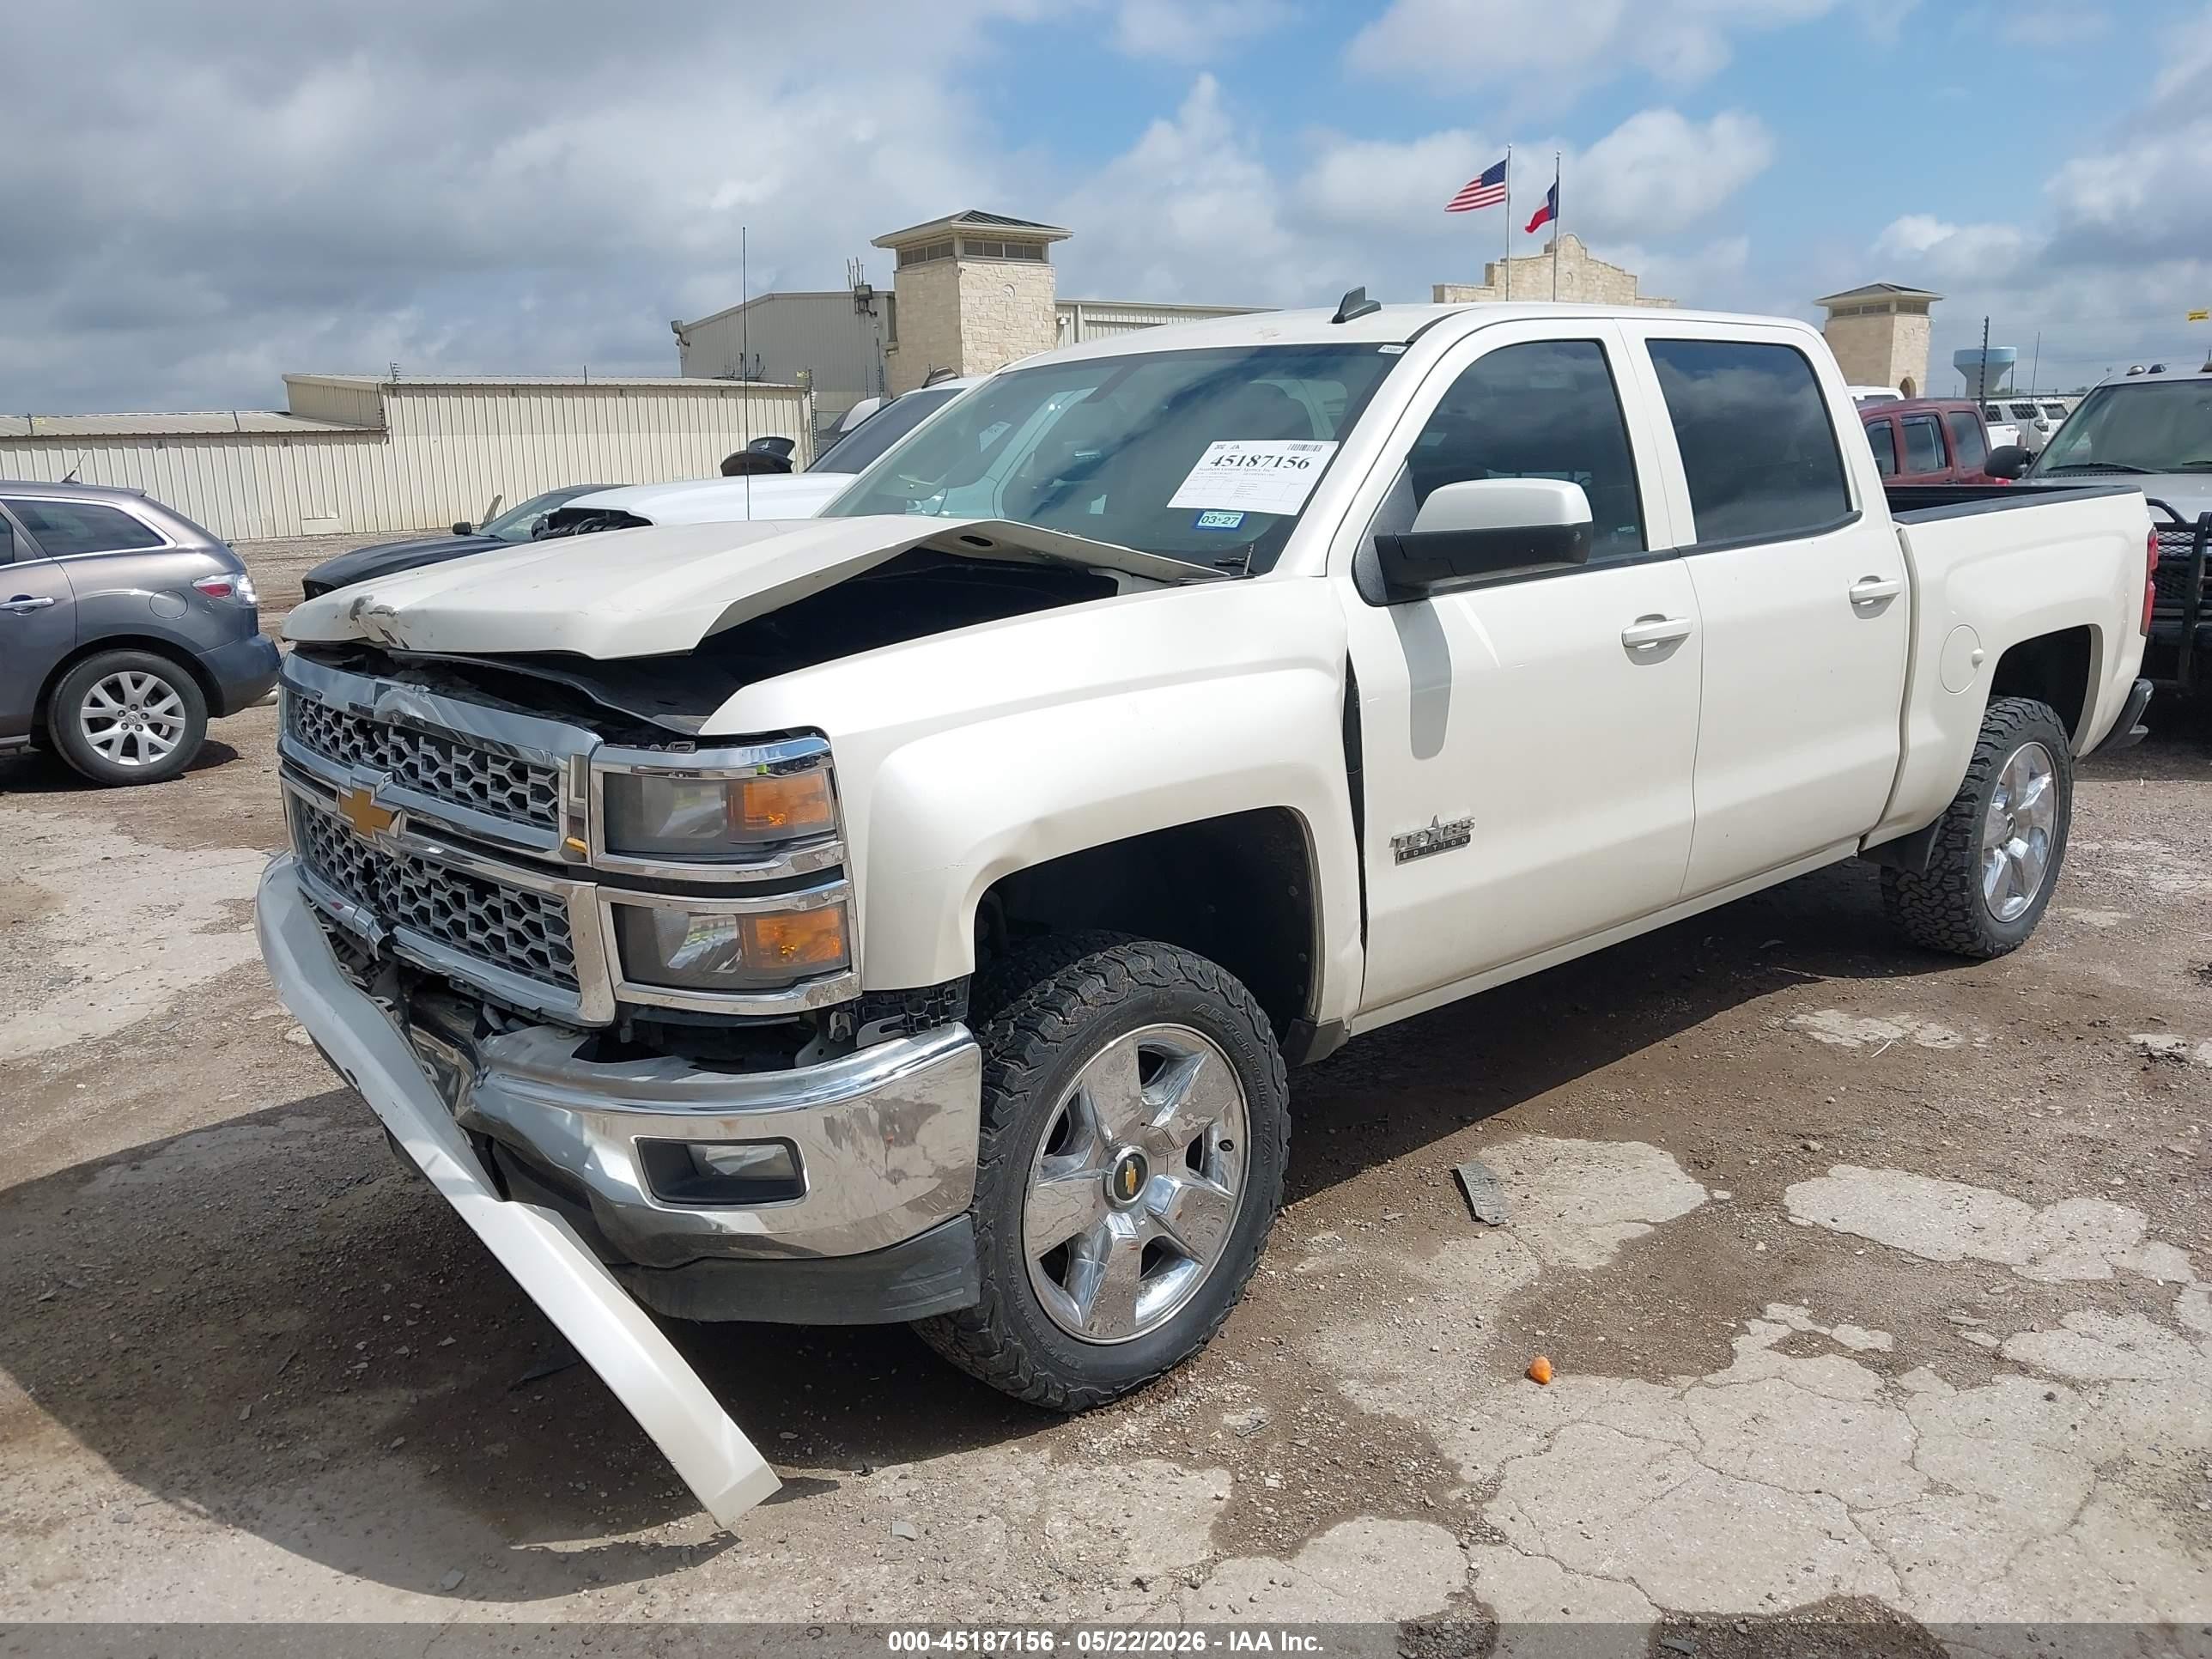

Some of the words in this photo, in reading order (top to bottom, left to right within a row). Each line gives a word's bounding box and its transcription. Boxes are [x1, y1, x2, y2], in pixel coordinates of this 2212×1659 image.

[1210, 454, 1313, 470] 45187156
[1200, 515, 1218, 524] 03
[1221, 516, 1239, 525] 27
[1401, 836, 1468, 860] EDITION
